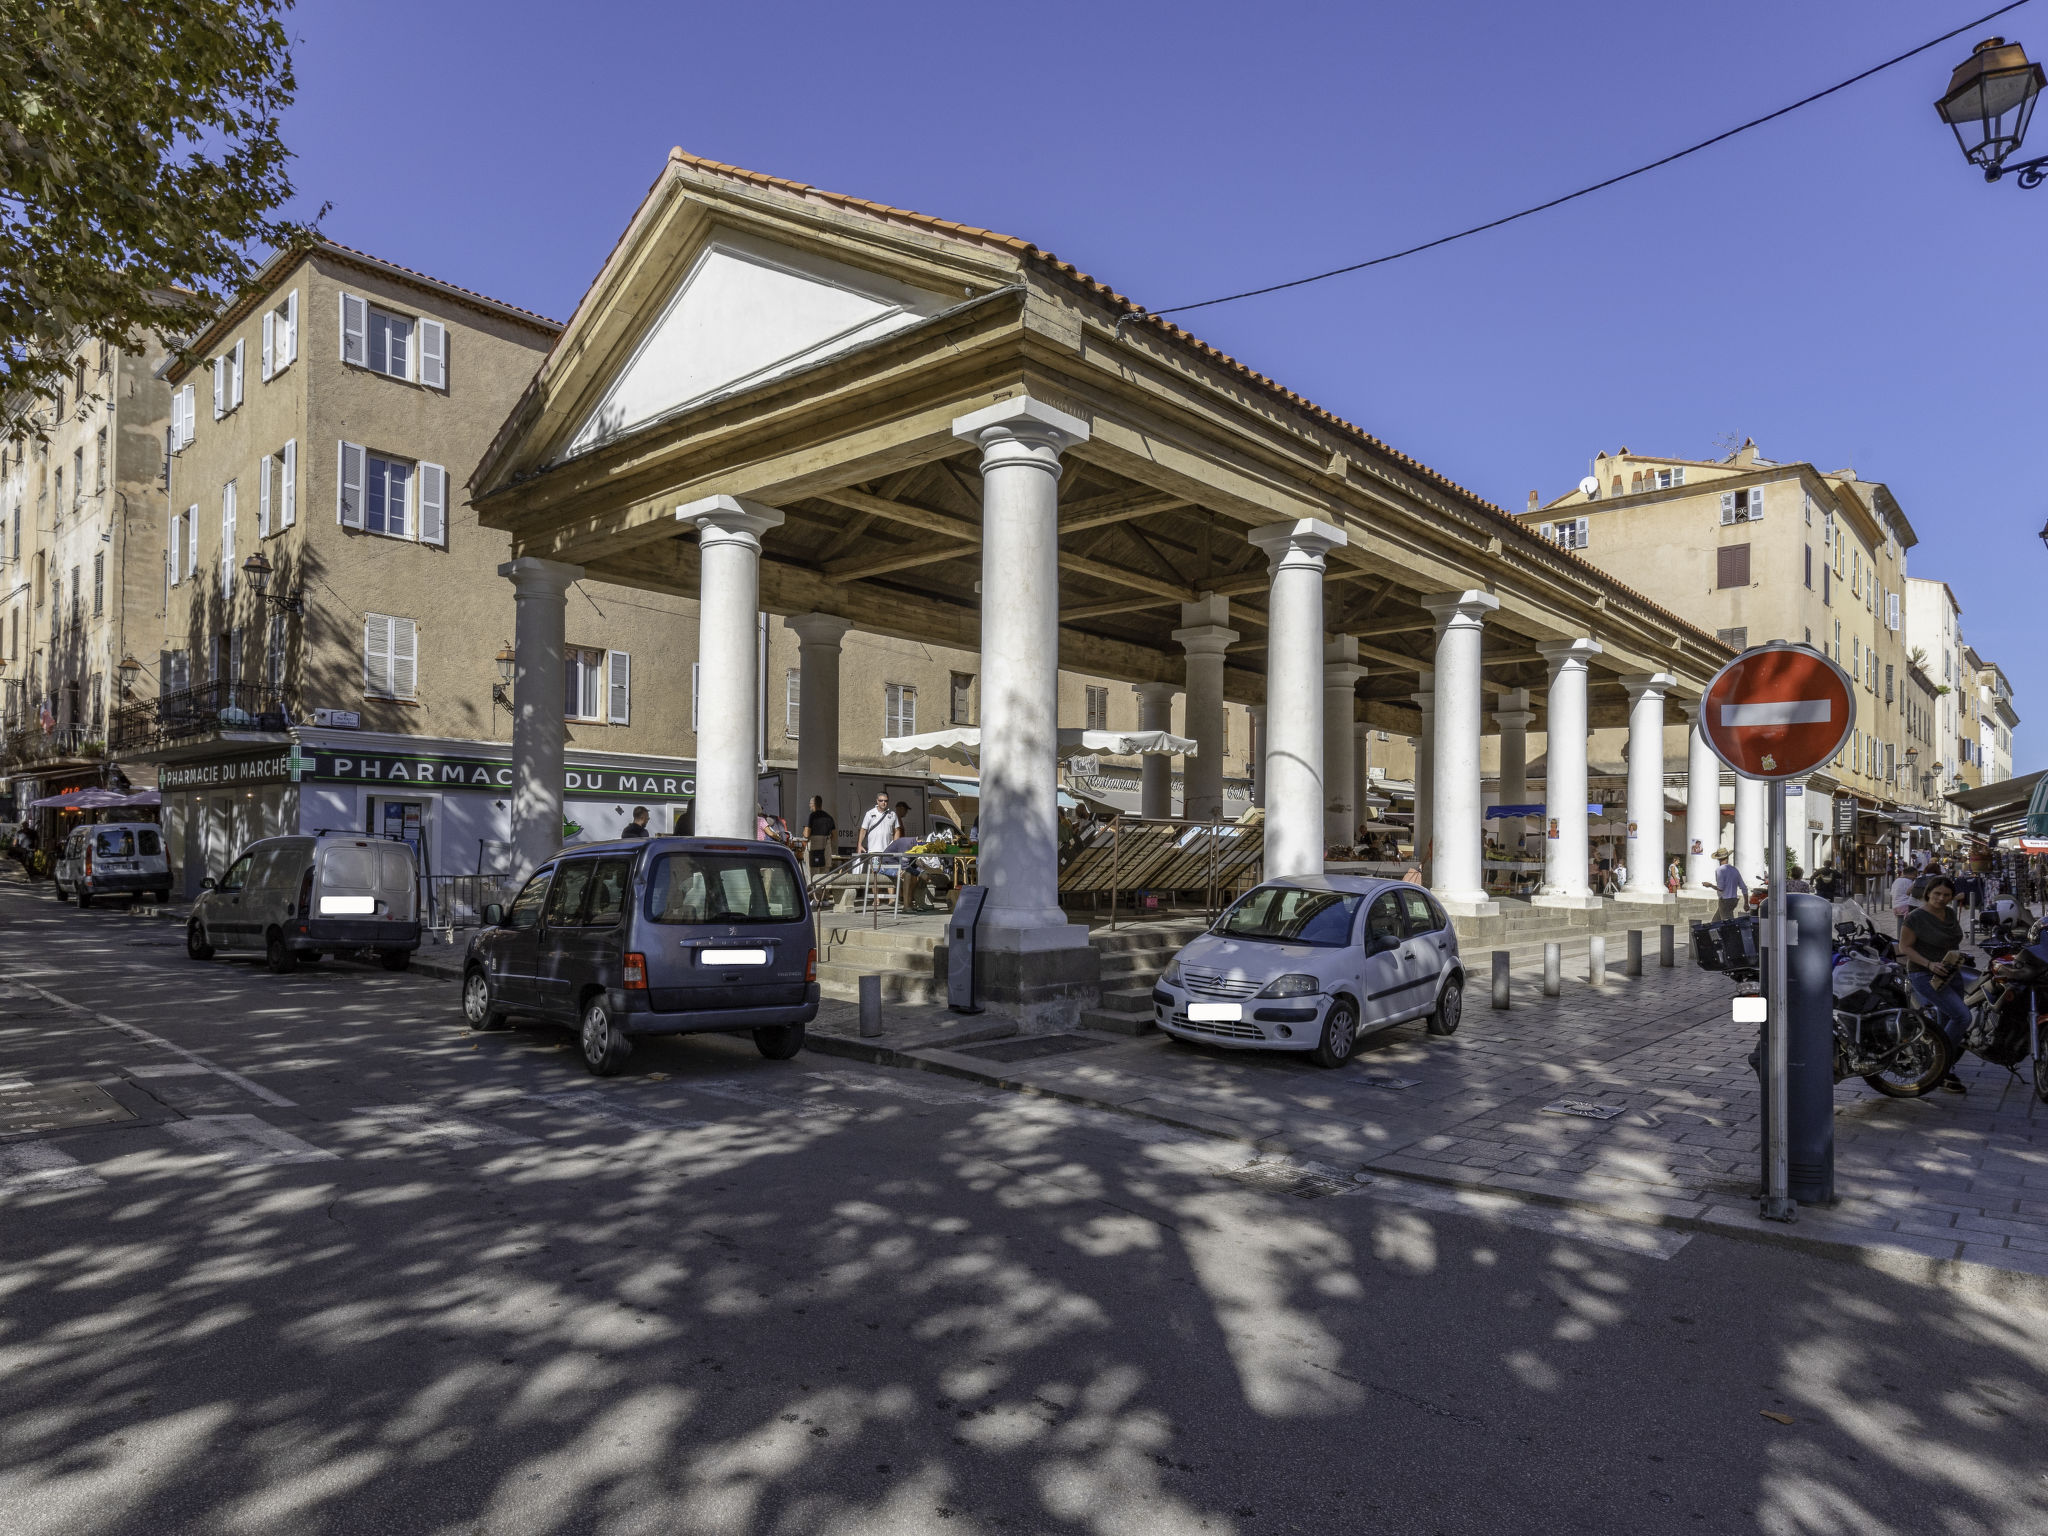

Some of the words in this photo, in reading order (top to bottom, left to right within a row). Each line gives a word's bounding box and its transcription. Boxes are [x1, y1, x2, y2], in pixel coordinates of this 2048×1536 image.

[167, 765, 218, 785] PHARMACIE
[222, 763, 236, 780] DU
[240, 755, 287, 778] MARCHÉ
[334, 758, 513, 785] PHARMAC
[566, 773, 602, 789] DU
[618, 775, 695, 795] MARC
[1087, 774, 1140, 792] Restaurant
[838, 829, 854, 838] orse
